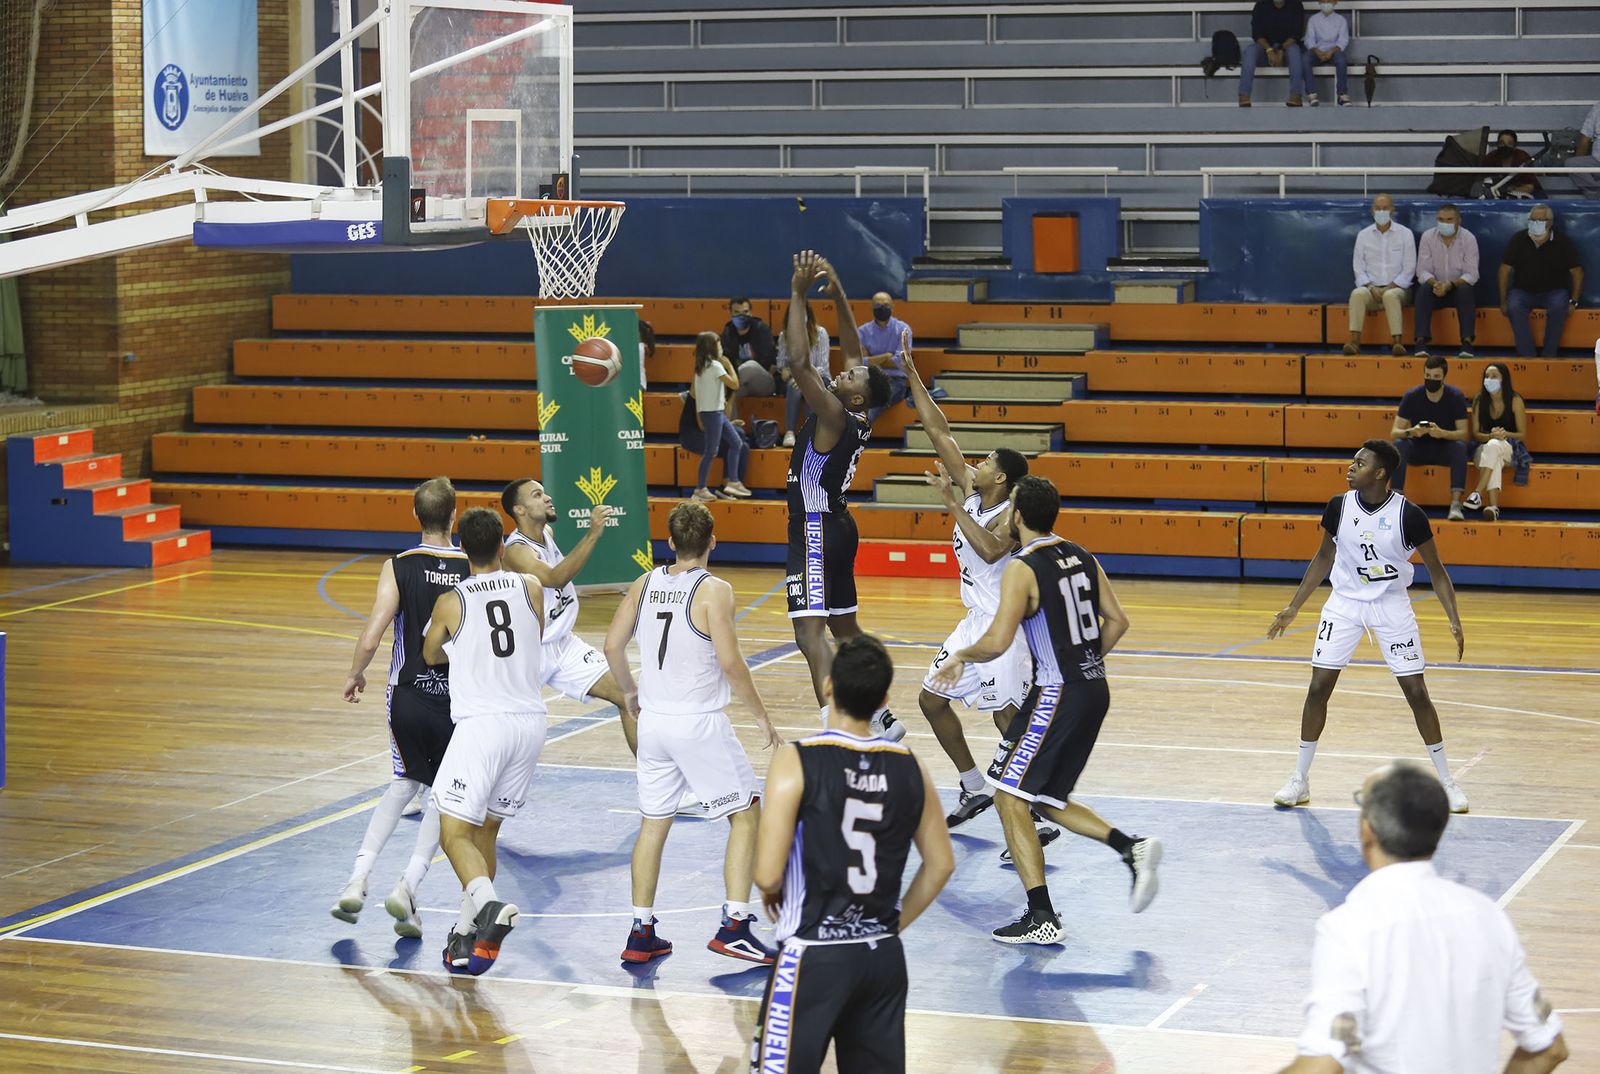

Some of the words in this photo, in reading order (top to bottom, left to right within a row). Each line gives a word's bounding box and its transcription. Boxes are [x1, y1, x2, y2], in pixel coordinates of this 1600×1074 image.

[190, 73, 248, 88] Ayuntamiento
[205, 89, 216, 101] de
[219, 89, 249, 102] Huelva
[346, 221, 377, 241] GES
[1024, 307, 1033, 318] F
[1050, 307, 1062, 318] 11
[997, 356, 1006, 367] F
[1024, 356, 1038, 368] 10
[972, 406, 981, 417] F
[998, 406, 1007, 417] 9
[1269, 410, 1280, 418] 47
[617, 429, 641, 440] CAJA
[540, 444, 562, 454] SUR
[626, 441, 644, 450] DEL
[1248, 463, 1261, 472] 47
[568, 508, 591, 518] CAJA
[915, 512, 924, 525] F
[942, 513, 949, 526] 7
[576, 519, 591, 528] DE
[605, 517, 619, 527] UR
[1223, 520, 1233, 528] 47
[1360, 543, 1379, 562] 21
[424, 570, 461, 586] TORRES
[808, 557, 823, 605] HUELVA
[1058, 572, 1100, 646] 16
[485, 599, 516, 659] 8
[1318, 620, 1333, 641] 21
[656, 611, 673, 670] 7
[1032, 684, 1060, 726] UELVA
[1003, 731, 1042, 780] HUELVA
[844, 768, 888, 793] TEJADA
[841, 798, 884, 895] 5
[774, 944, 803, 992] ELVA
[762, 1002, 791, 1074] HUELV
